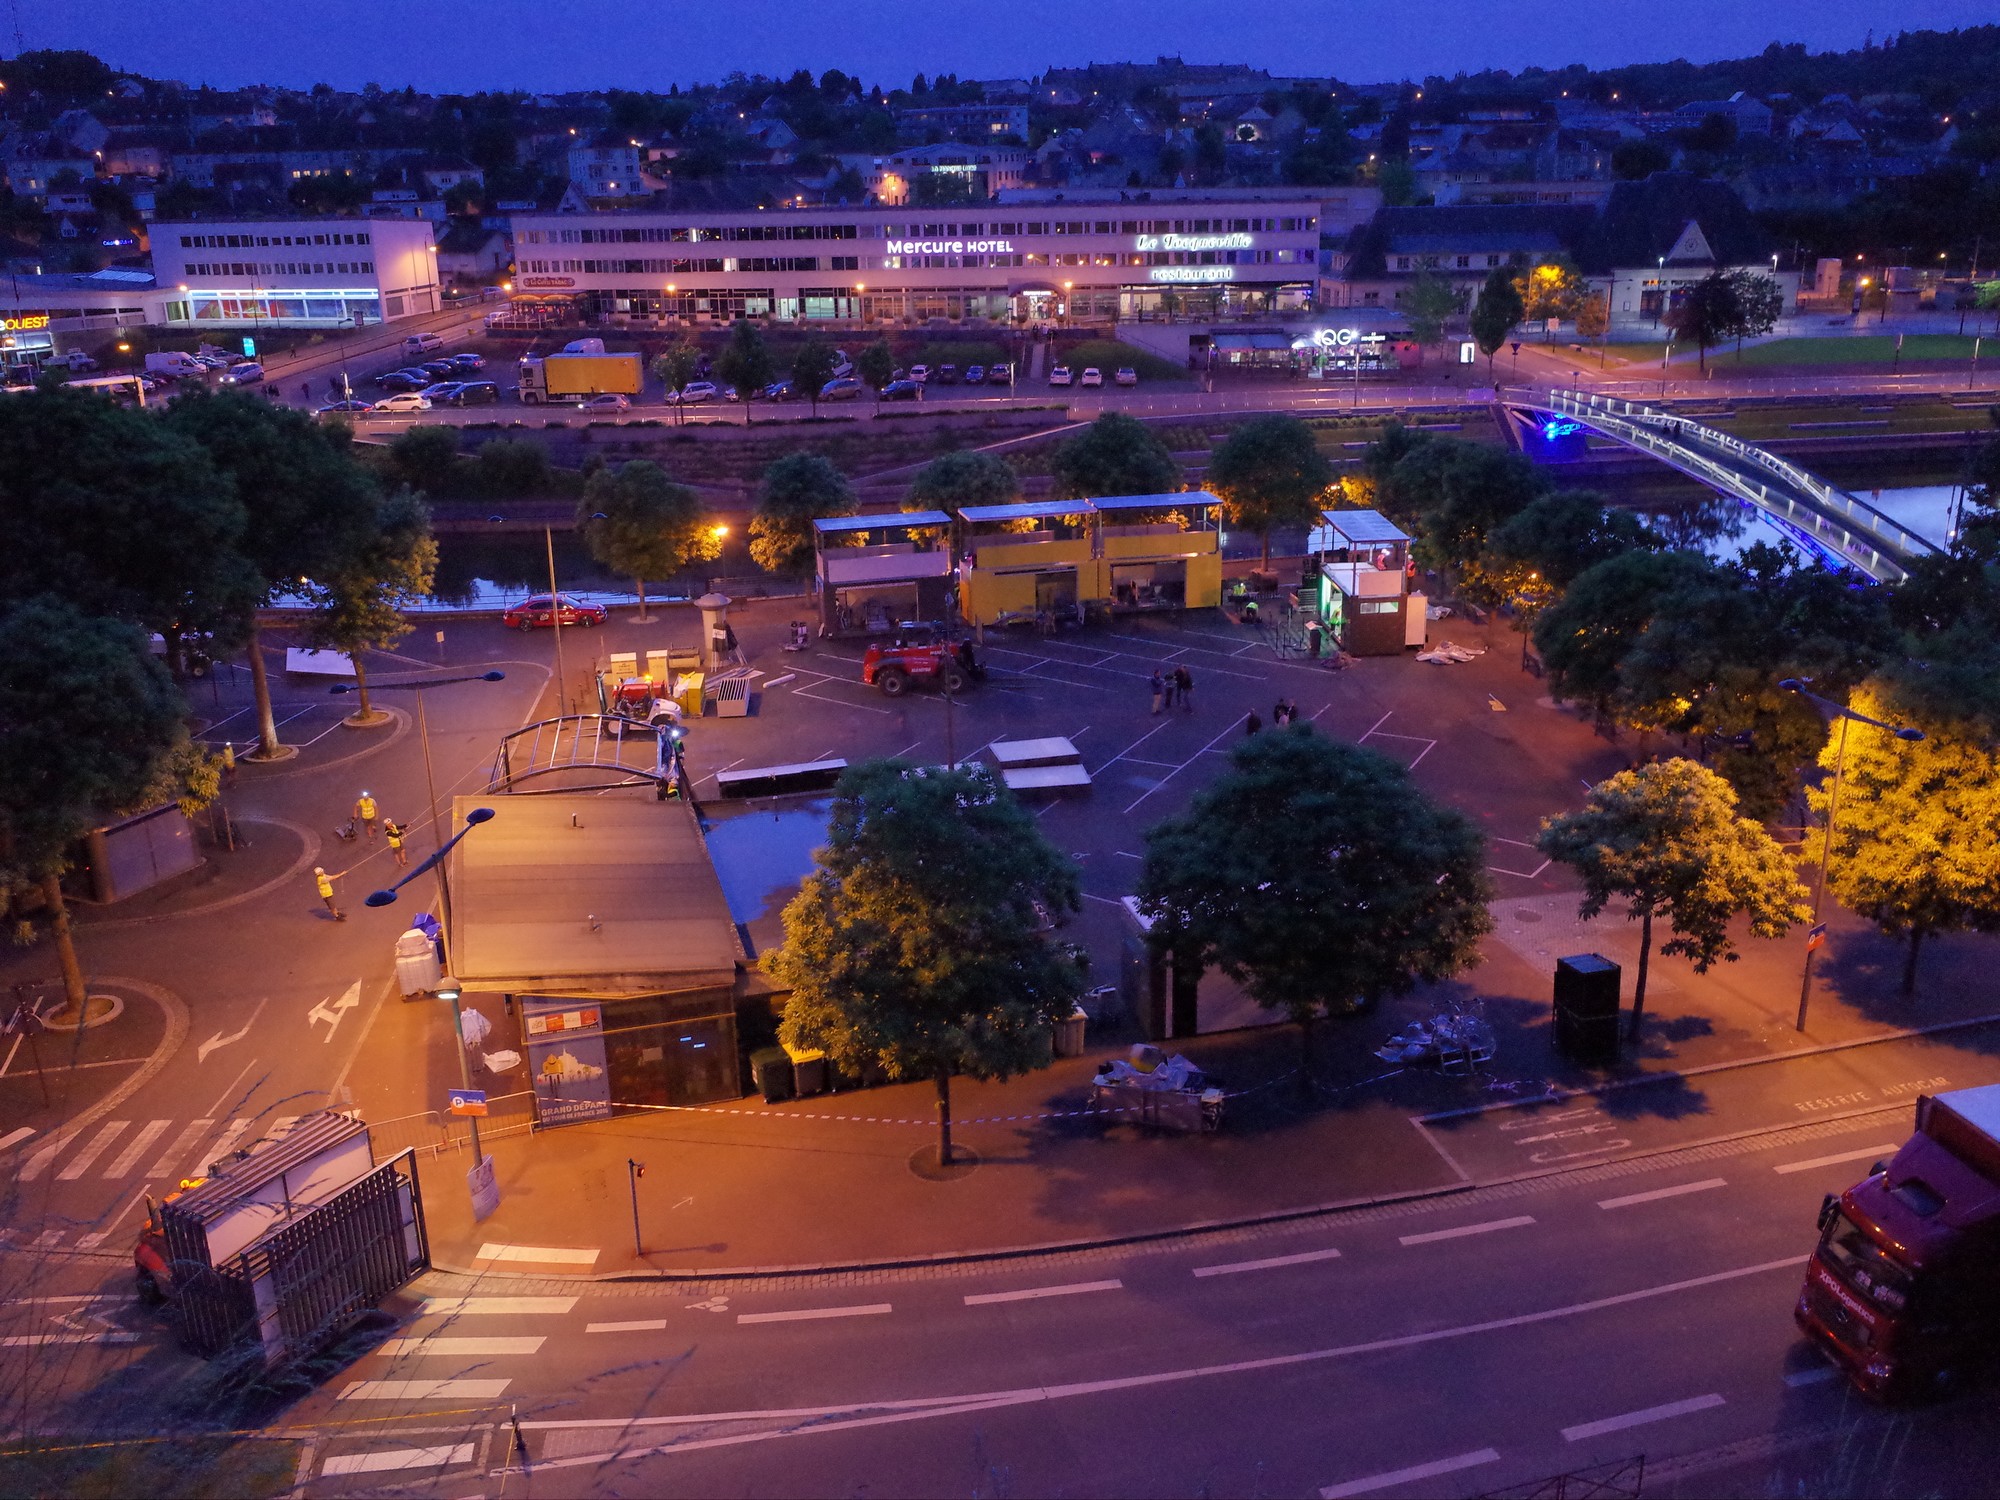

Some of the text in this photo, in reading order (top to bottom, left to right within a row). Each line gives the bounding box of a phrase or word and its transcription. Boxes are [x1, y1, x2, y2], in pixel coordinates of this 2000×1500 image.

[887, 241, 1013, 254] Mercure HOTEL
[1137, 233, 1252, 251] Le Tocqueville
[1151, 267, 1232, 280] restaurant
[1321, 329, 1352, 345] QG
[1795, 1076, 1952, 1112] RESERVE AUTOCAR
[541, 1105, 572, 1116] GRAND
[574, 1109, 595, 1118] FRANCE
